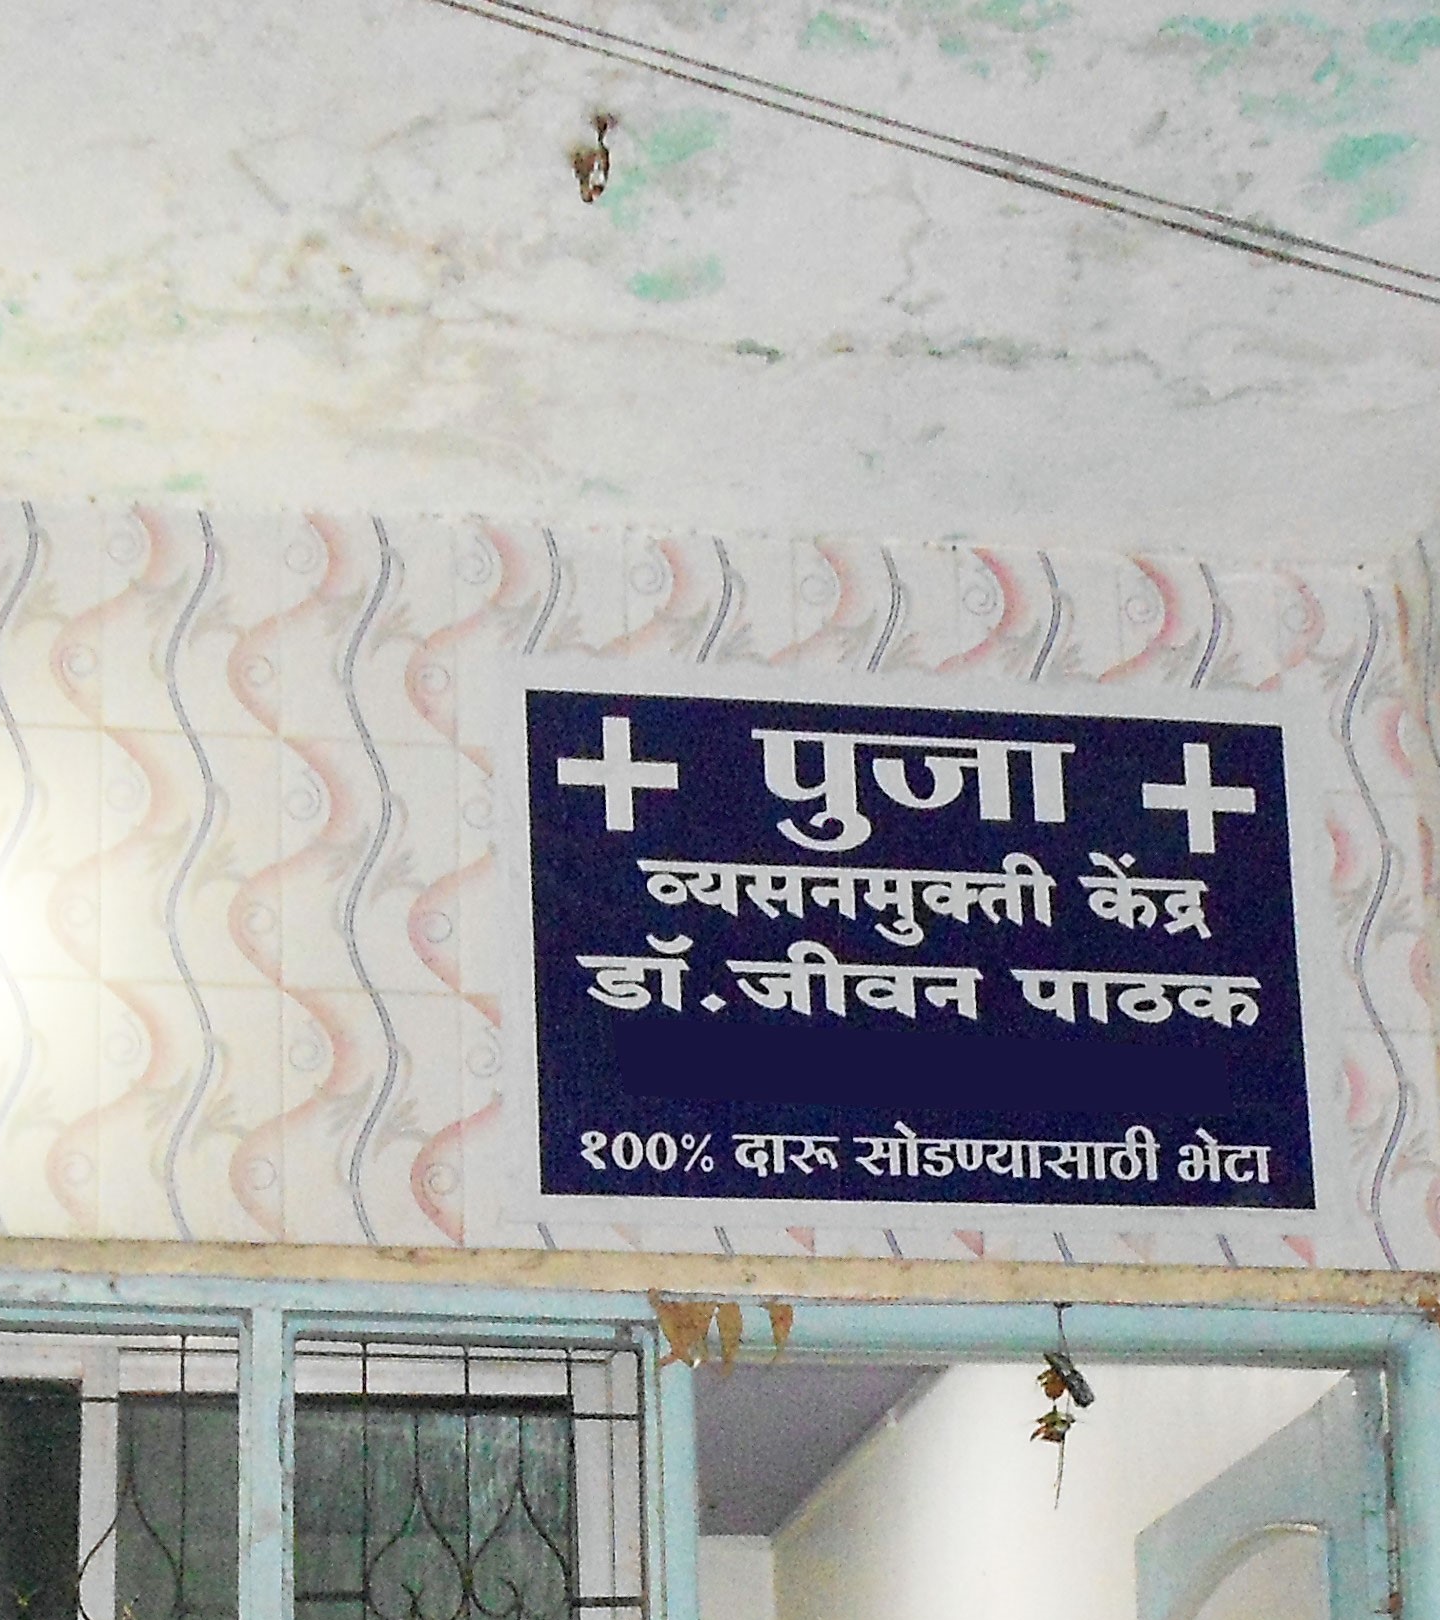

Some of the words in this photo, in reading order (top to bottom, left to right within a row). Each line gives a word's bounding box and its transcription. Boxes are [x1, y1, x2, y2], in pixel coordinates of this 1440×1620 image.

[752, 728, 1076, 852] पुजा
[637, 852, 1057, 948] व्यसनमुक्ती
[1078, 850, 1212, 941] केंद्र
[1010, 968, 1262, 1029] पाठक
[731, 1134, 840, 1178] दारू
[852, 1120, 1161, 1182] सोडण्यासाठी
[1177, 1127, 1272, 1184] भेटा
